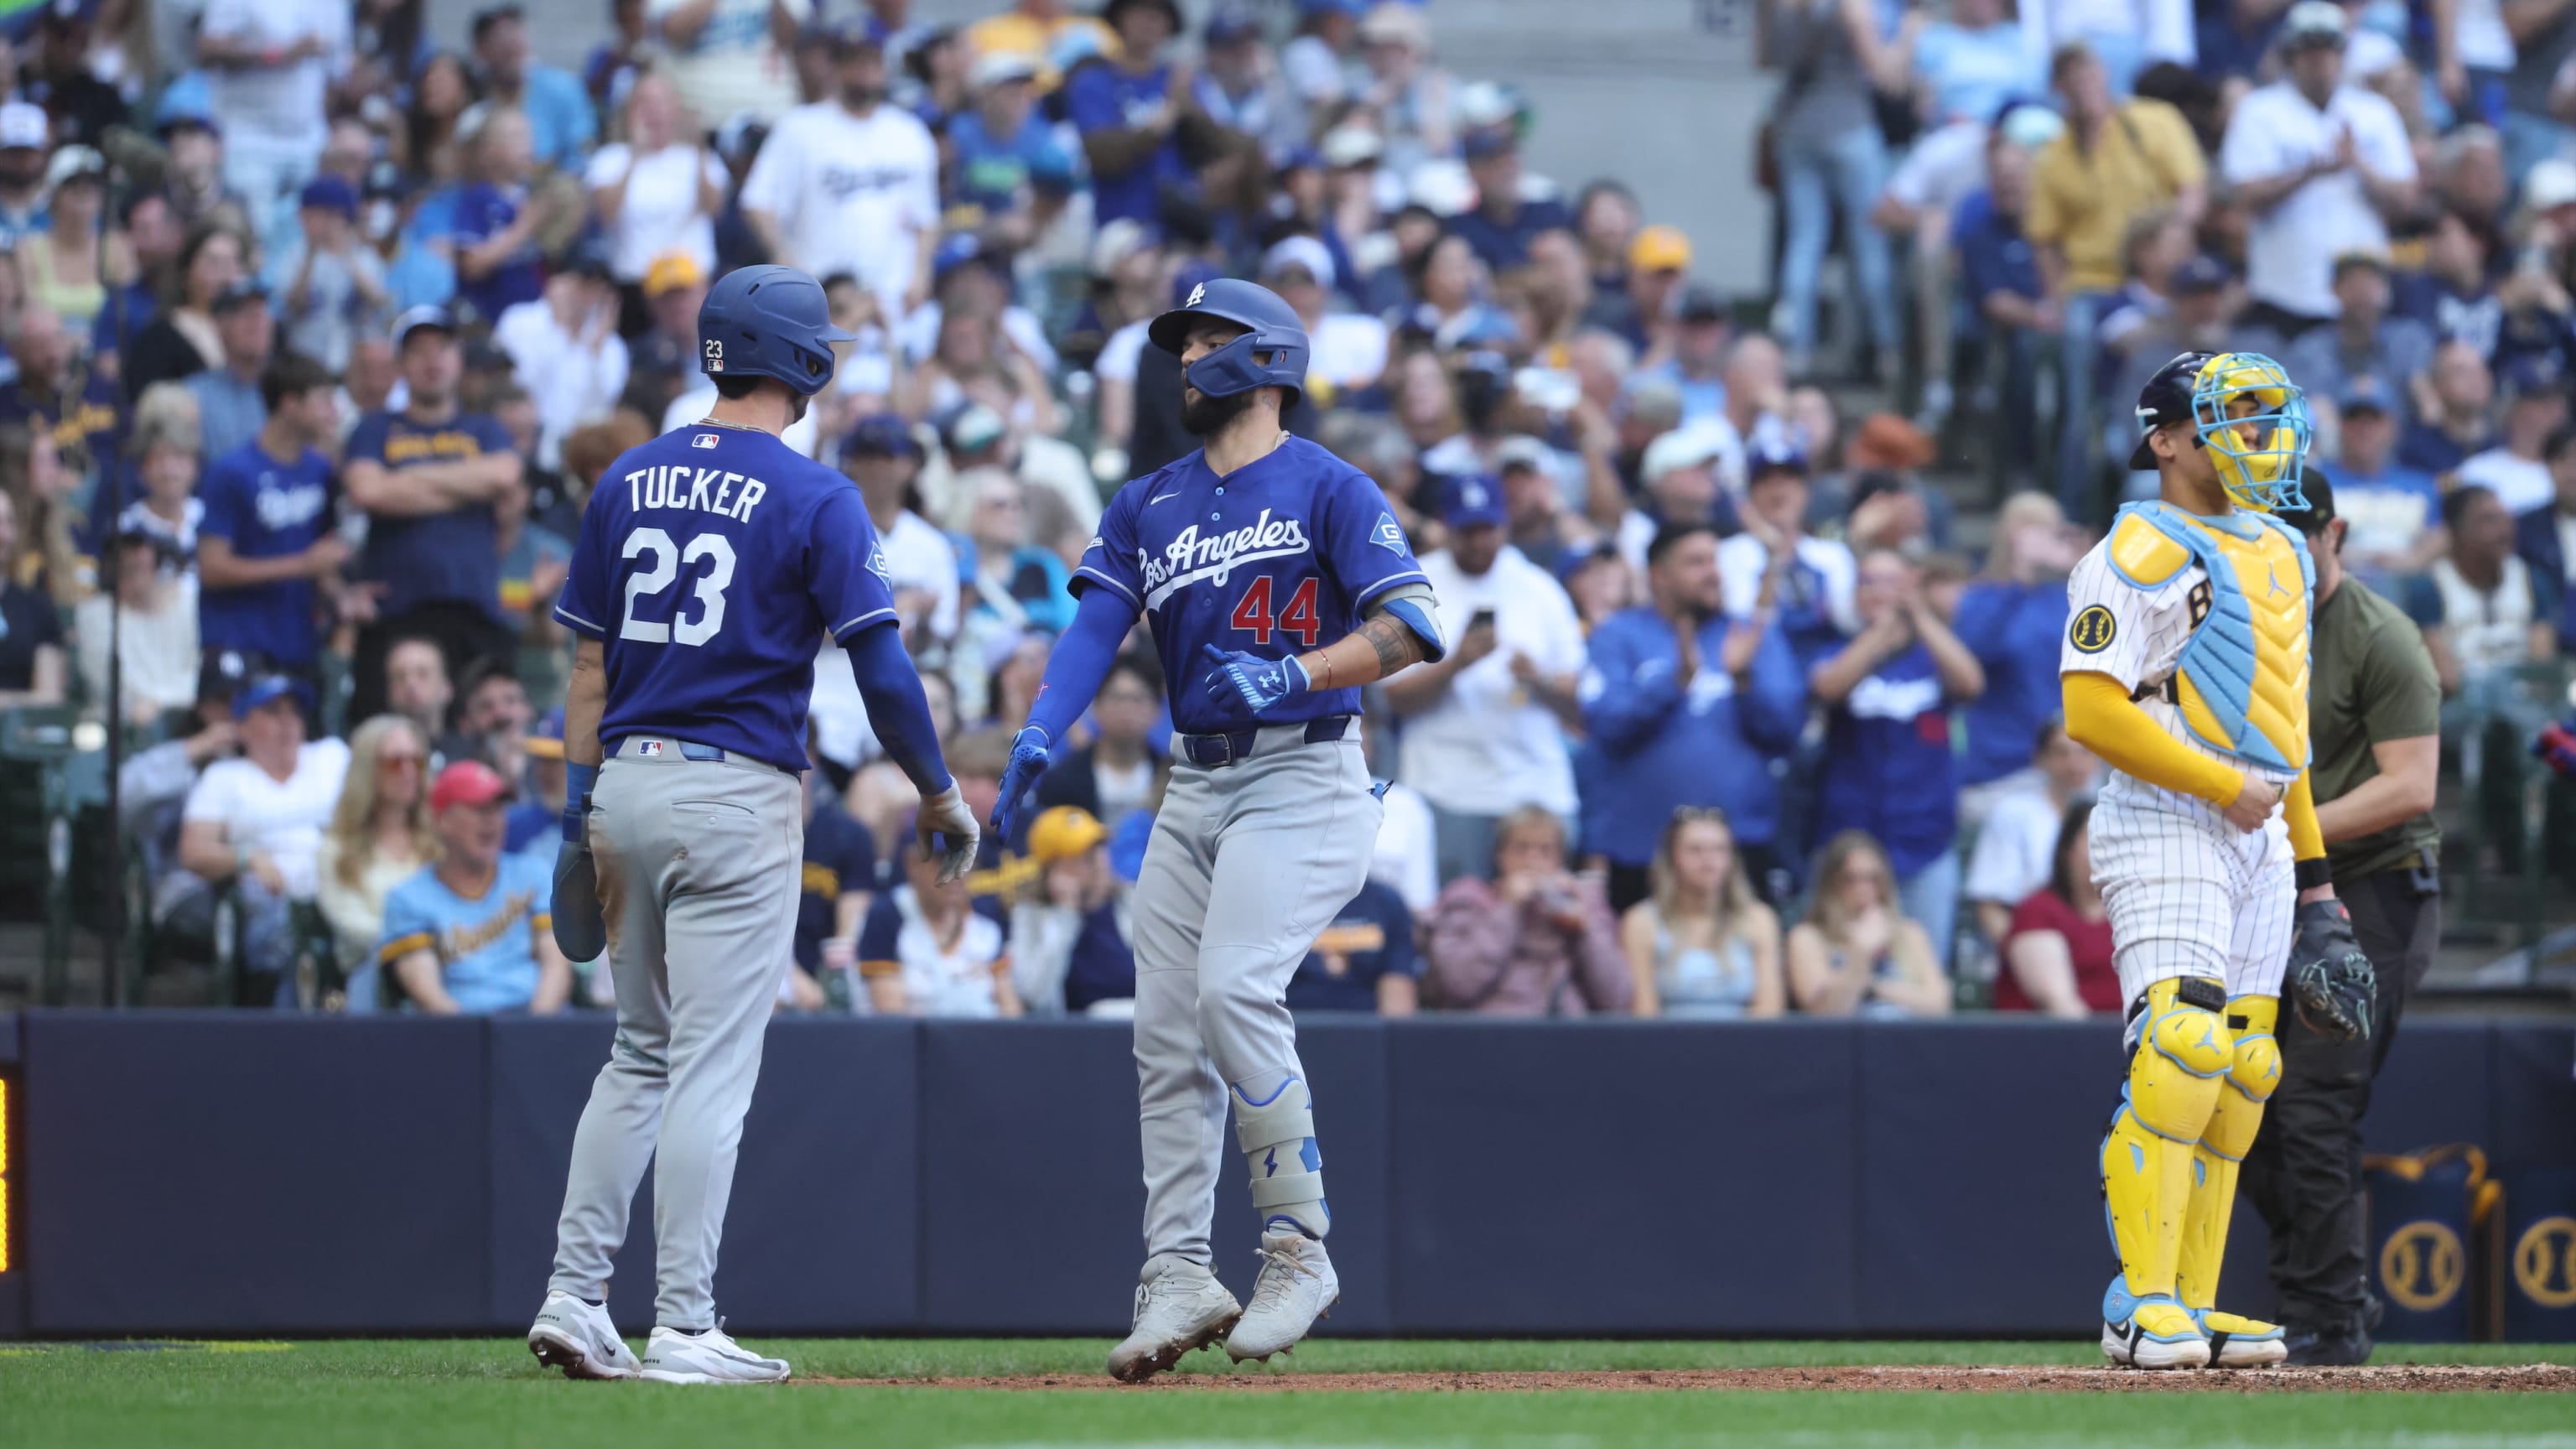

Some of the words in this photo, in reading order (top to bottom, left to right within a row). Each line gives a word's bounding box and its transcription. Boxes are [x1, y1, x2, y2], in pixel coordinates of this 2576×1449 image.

[706, 339, 723, 359] 23
[625, 465, 766, 524] TUCKER
[1166, 508, 1310, 587] Angeles
[620, 527, 737, 647] 23
[1231, 575, 1320, 646] 44
